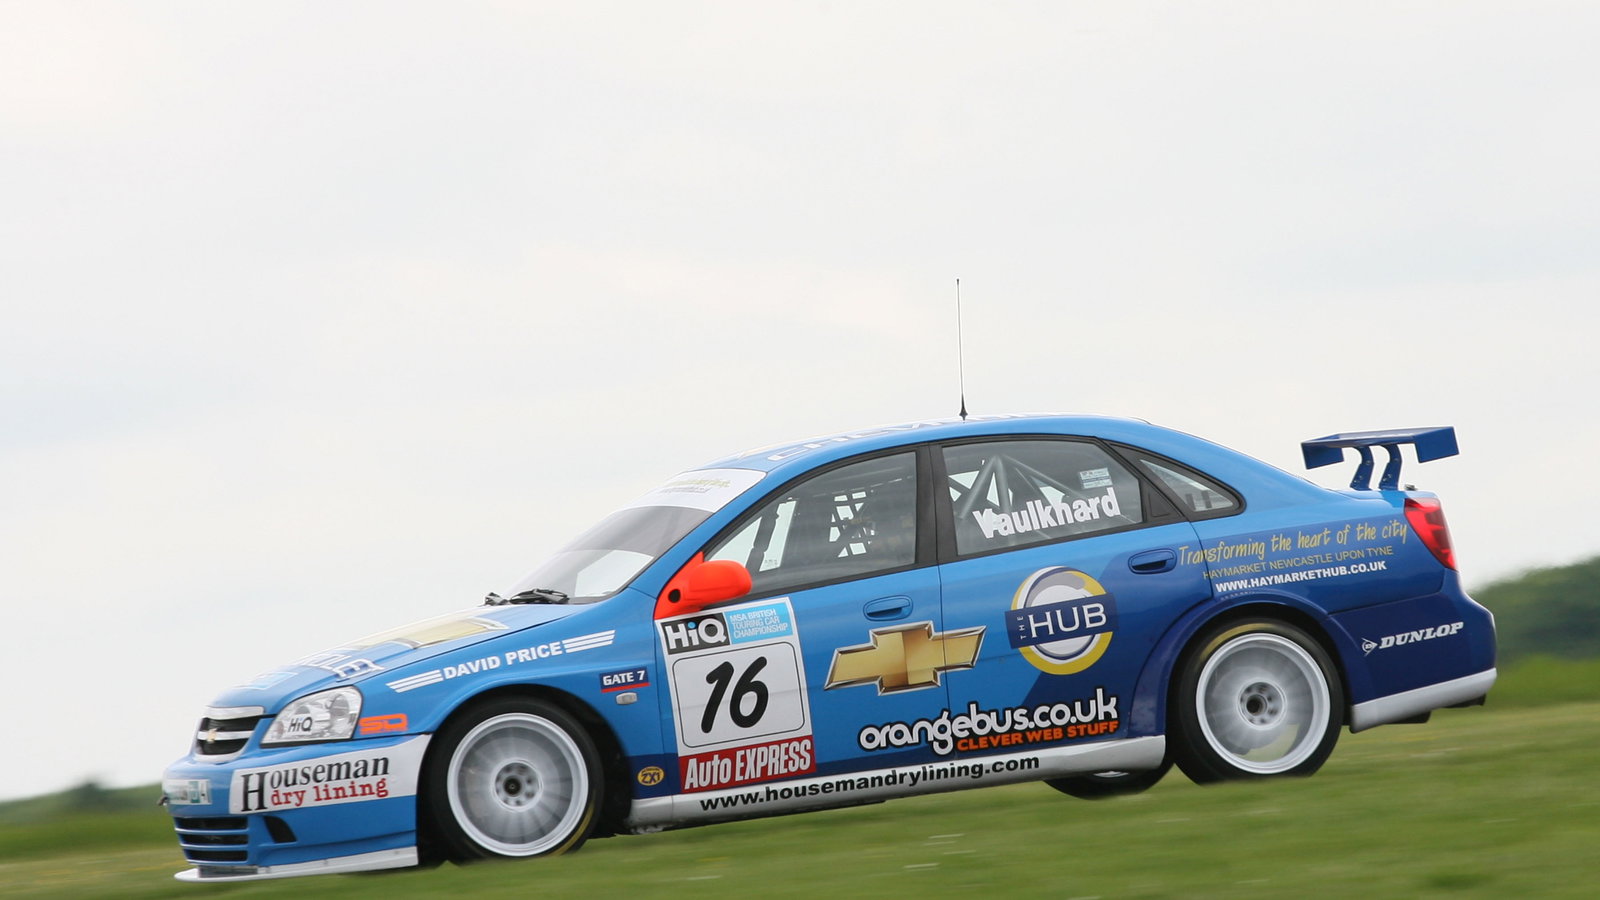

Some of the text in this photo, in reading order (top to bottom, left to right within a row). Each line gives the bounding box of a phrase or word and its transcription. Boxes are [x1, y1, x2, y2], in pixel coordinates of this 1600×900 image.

[972, 487, 1121, 539] Vaulkhard
[1179, 520, 1407, 566] Transforming the heart of the city
[1203, 545, 1394, 580] HAYMARKET NEWCASTLE UPON TYNE
[1215, 560, 1387, 593] WWW.HAYMARKETHUB.CO.UK
[732, 619, 764, 630] TOURING
[733, 622, 788, 639] CHAMPIONSHIP
[748, 608, 776, 619] BRITISH
[1028, 603, 1107, 638] HUB
[664, 618, 728, 650] HiQ
[1379, 621, 1464, 649] DUNLOP
[443, 641, 564, 680] DAVID PRICE
[602, 669, 647, 686] GATE 7
[701, 656, 769, 734] 16
[859, 688, 1119, 755] orangebus.co.uk
[957, 720, 1119, 751] CLEVER WEB STUFF
[684, 739, 812, 790] Auto EXPRESS
[241, 757, 389, 812] Houseman
[270, 777, 389, 806] dry lining
[700, 756, 1040, 811] www.housemandrylining.com
